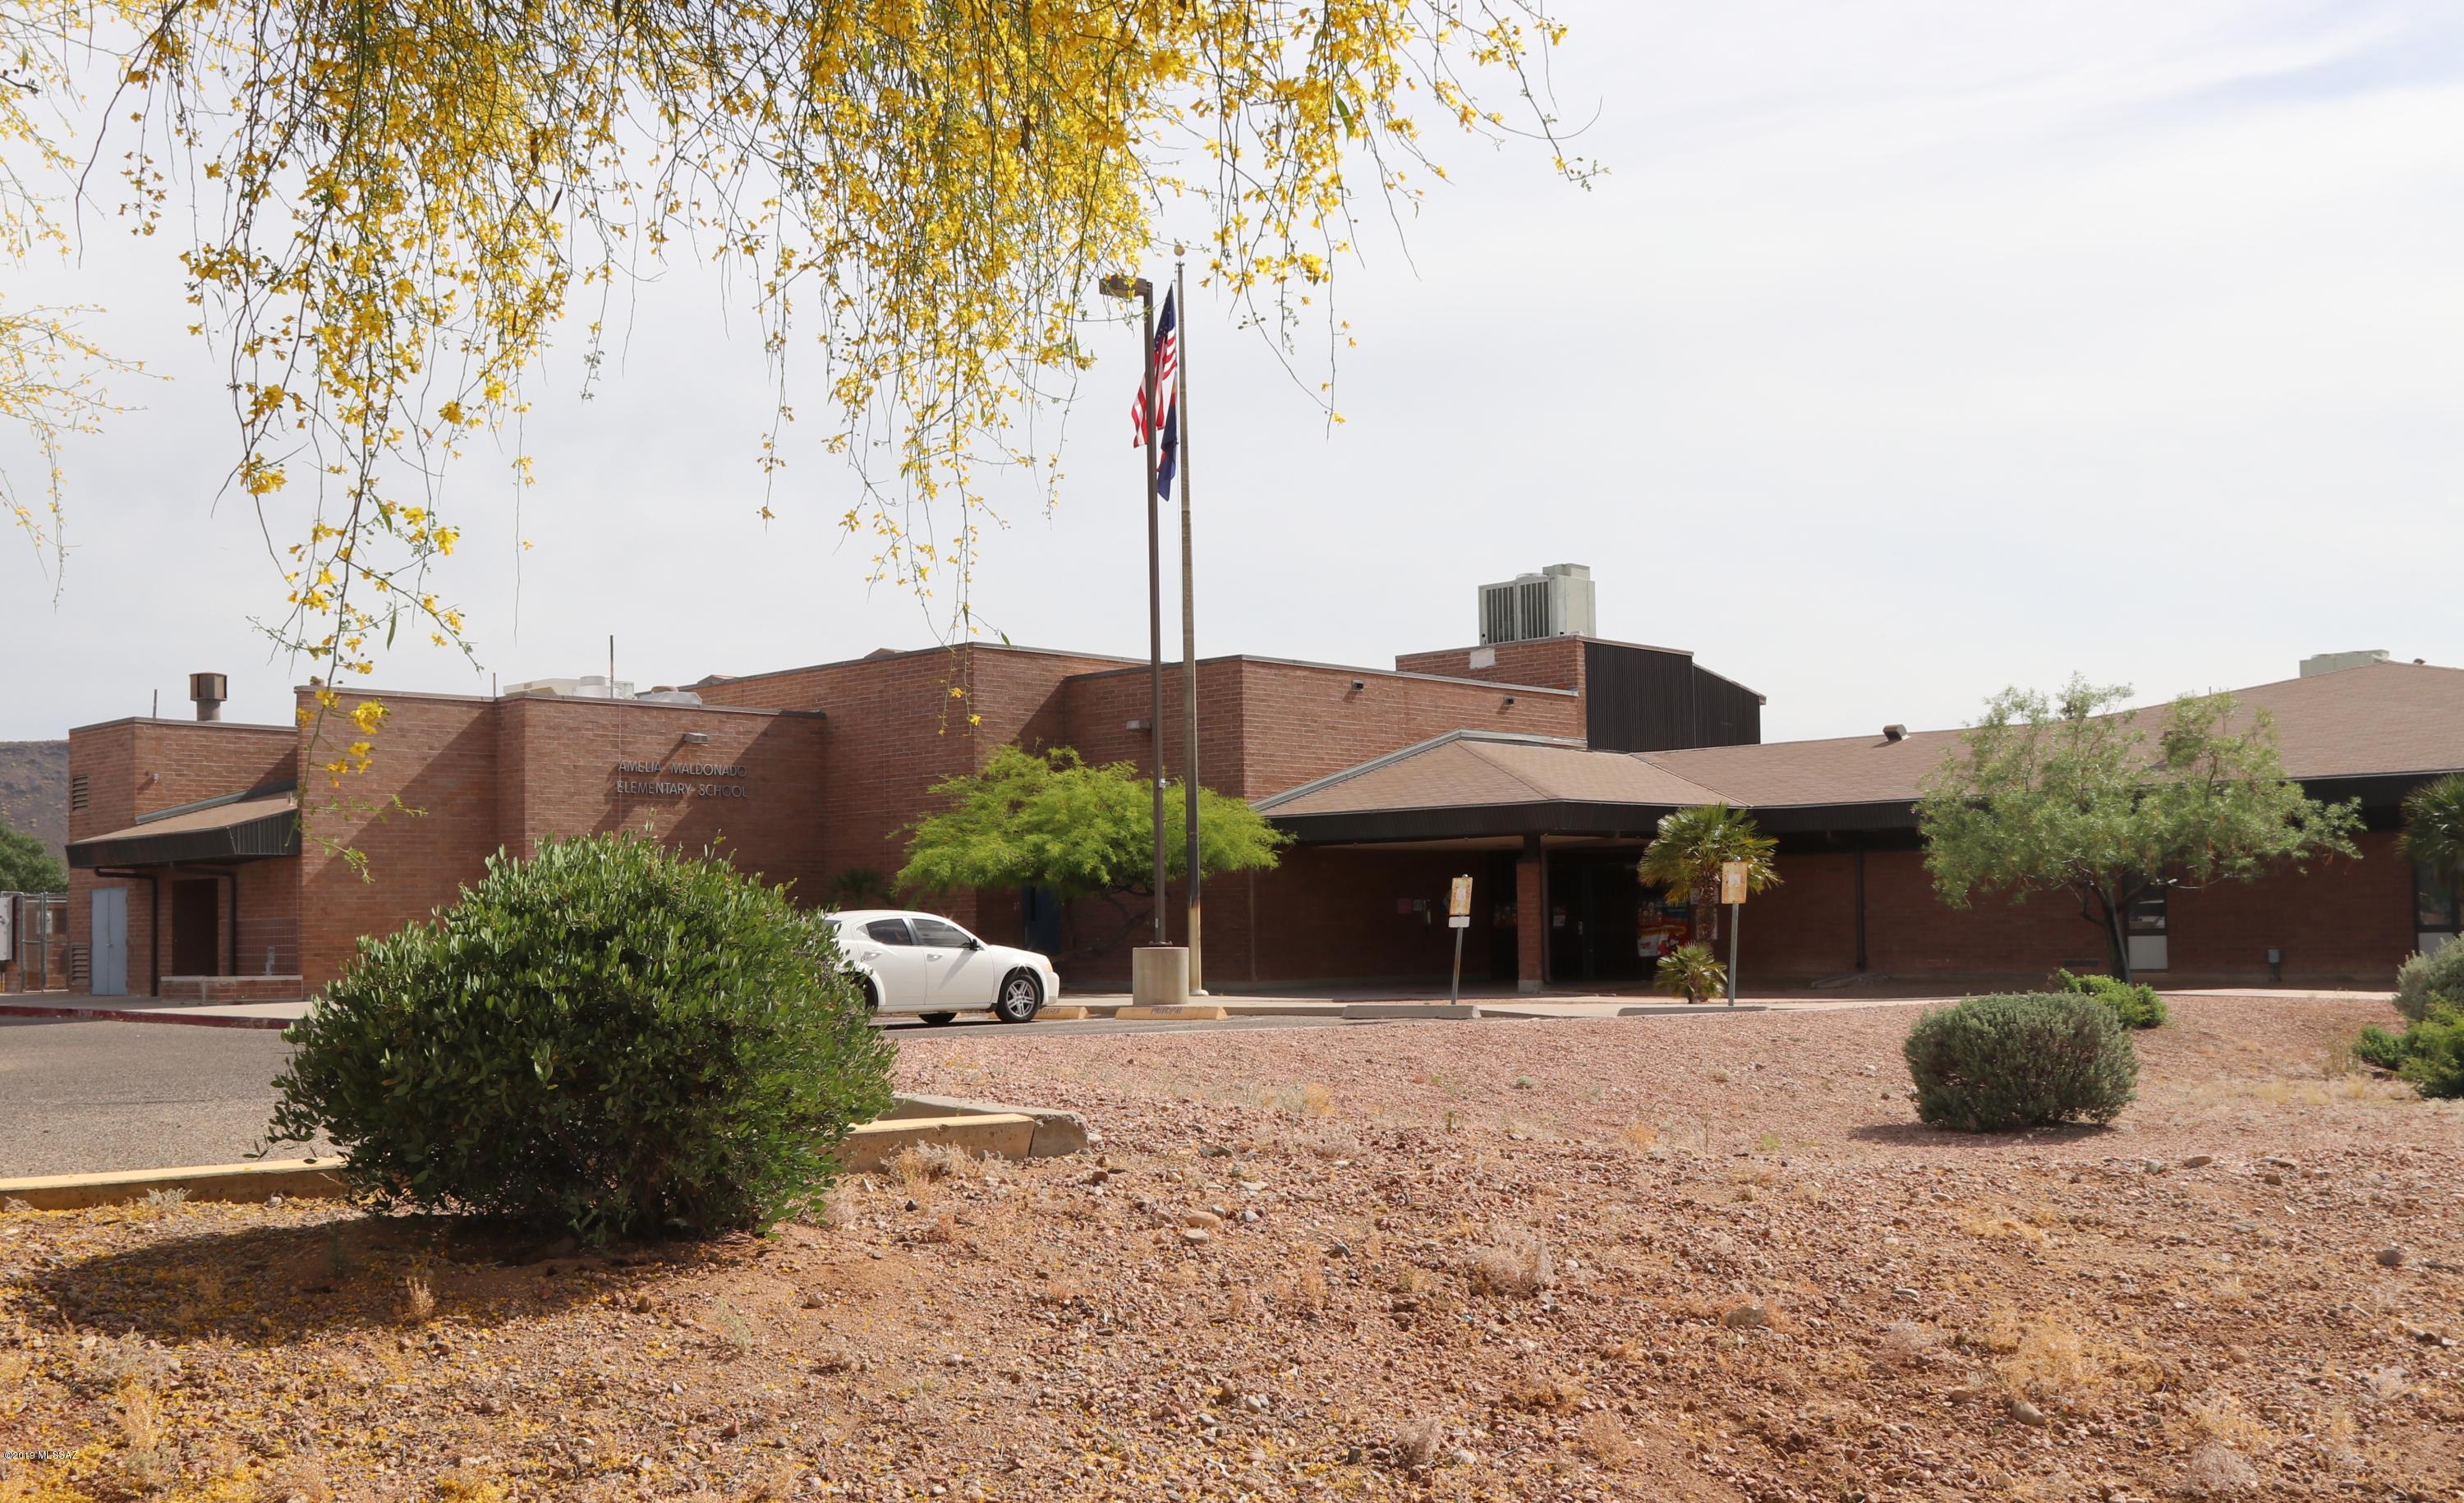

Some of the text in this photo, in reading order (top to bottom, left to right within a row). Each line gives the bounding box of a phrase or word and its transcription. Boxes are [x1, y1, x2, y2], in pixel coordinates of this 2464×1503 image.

[618, 761, 747, 777] AMELIA MALDONADO
[617, 781, 747, 797] ELEMENTARY SCHOOL
